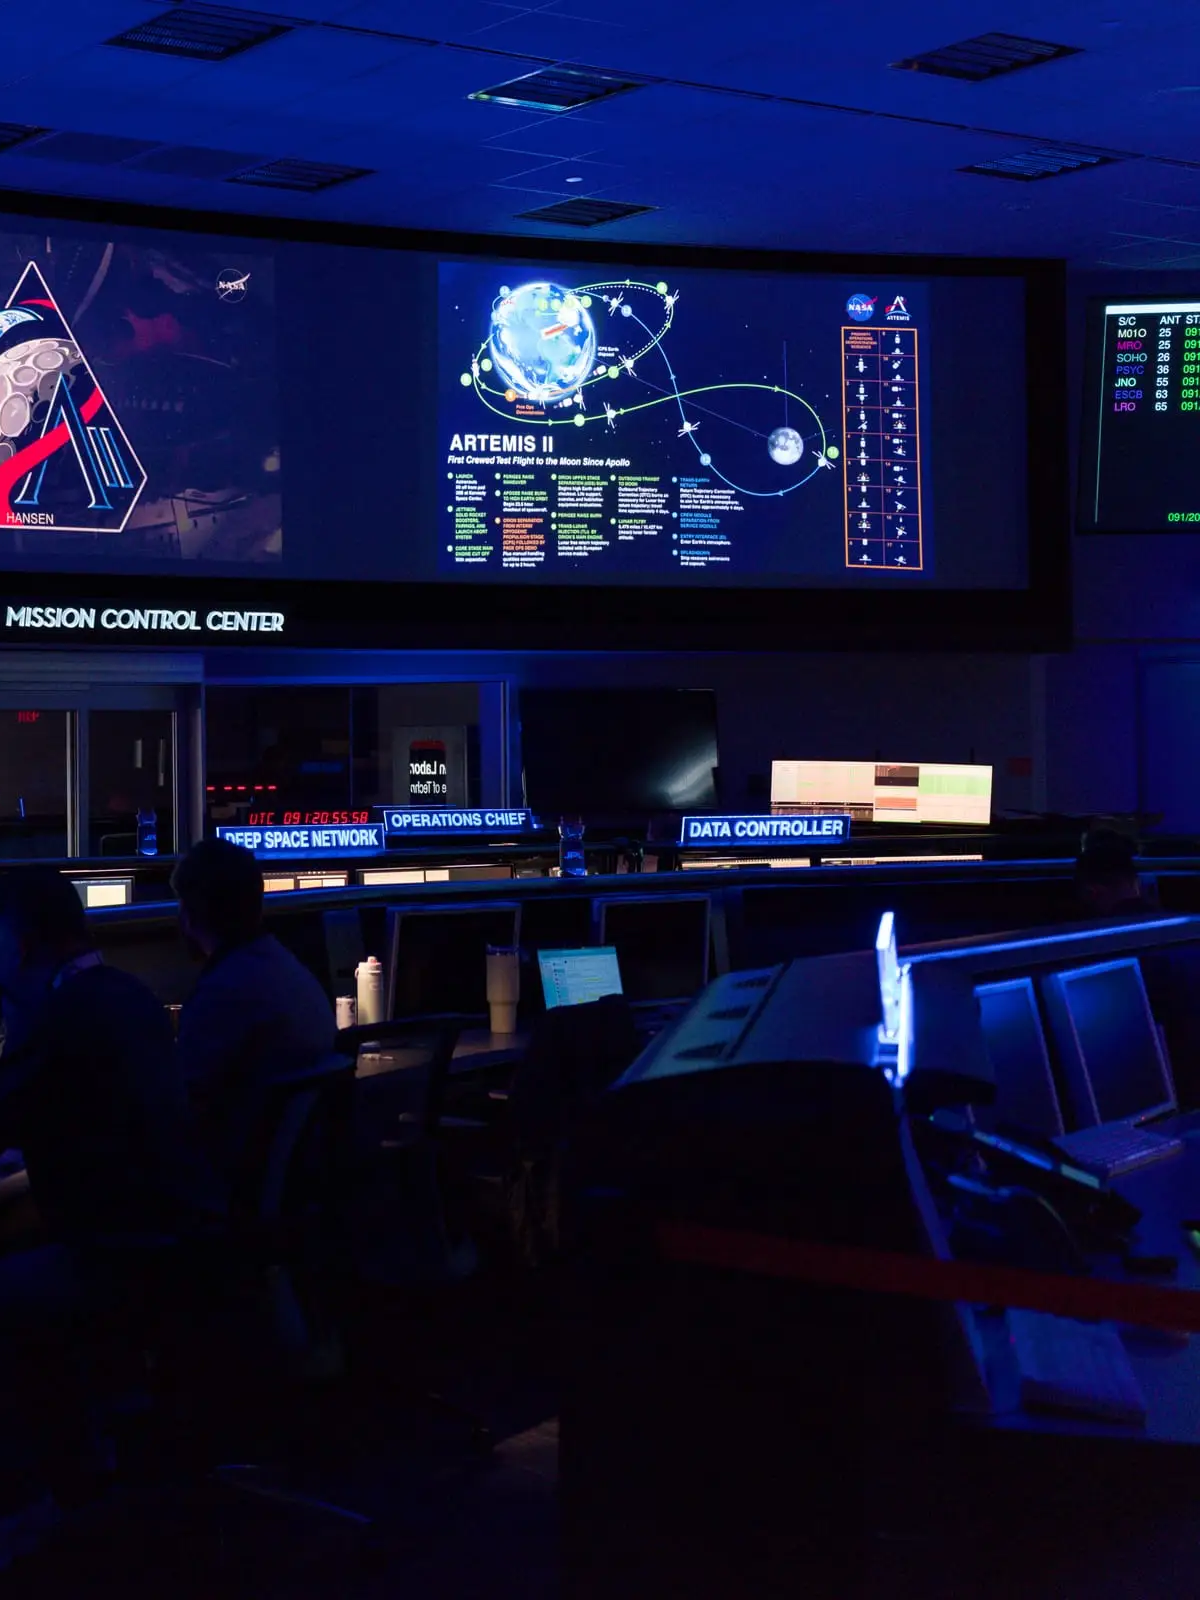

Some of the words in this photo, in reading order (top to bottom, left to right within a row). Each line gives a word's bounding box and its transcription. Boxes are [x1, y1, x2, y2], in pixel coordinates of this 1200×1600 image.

[1118, 316, 1137, 326] S/C
[1160, 315, 1182, 325] ANT
[1186, 315, 1200, 324] ST
[1159, 328, 1172, 337] 25
[1117, 341, 1142, 350] MRO
[1158, 340, 1171, 350] 25
[1116, 353, 1148, 363] SOHO
[1157, 353, 1170, 362] 26
[1116, 365, 1144, 375] PSYC
[1156, 365, 1170, 374] 36
[1115, 378, 1137, 387] JNO
[1156, 378, 1169, 386] 55
[1115, 390, 1143, 399] ESCB
[1155, 390, 1168, 399] 63
[1181, 389, 1200, 398] 091
[1114, 402, 1136, 412] LRO
[1155, 402, 1167, 411] 65
[1181, 402, 1200, 411] 091
[449, 434, 536, 452] ARTEMIS
[542, 436, 553, 454] II
[448, 455, 464, 464] First
[466, 456, 495, 465] Crewed
[496, 456, 511, 465] Test
[512, 456, 535, 467] Flight
[535, 457, 544, 465] to
[545, 456, 558, 466] the
[559, 457, 581, 466] Moon
[582, 457, 604, 466] Since
[605, 457, 631, 468] Apollo
[6, 513, 54, 524] HANSEN
[5, 606, 95, 630] MISSION
[101, 608, 201, 631] CONTROL
[206, 610, 285, 632] CENTER
[250, 812, 275, 825] UTC
[392, 813, 484, 828] OPERATIONS
[486, 812, 526, 826] CHIEF
[689, 820, 731, 838] DATA
[734, 819, 844, 837] CONTROLLER
[264, 831, 309, 849] SPACE
[311, 829, 379, 847] NETWORK
